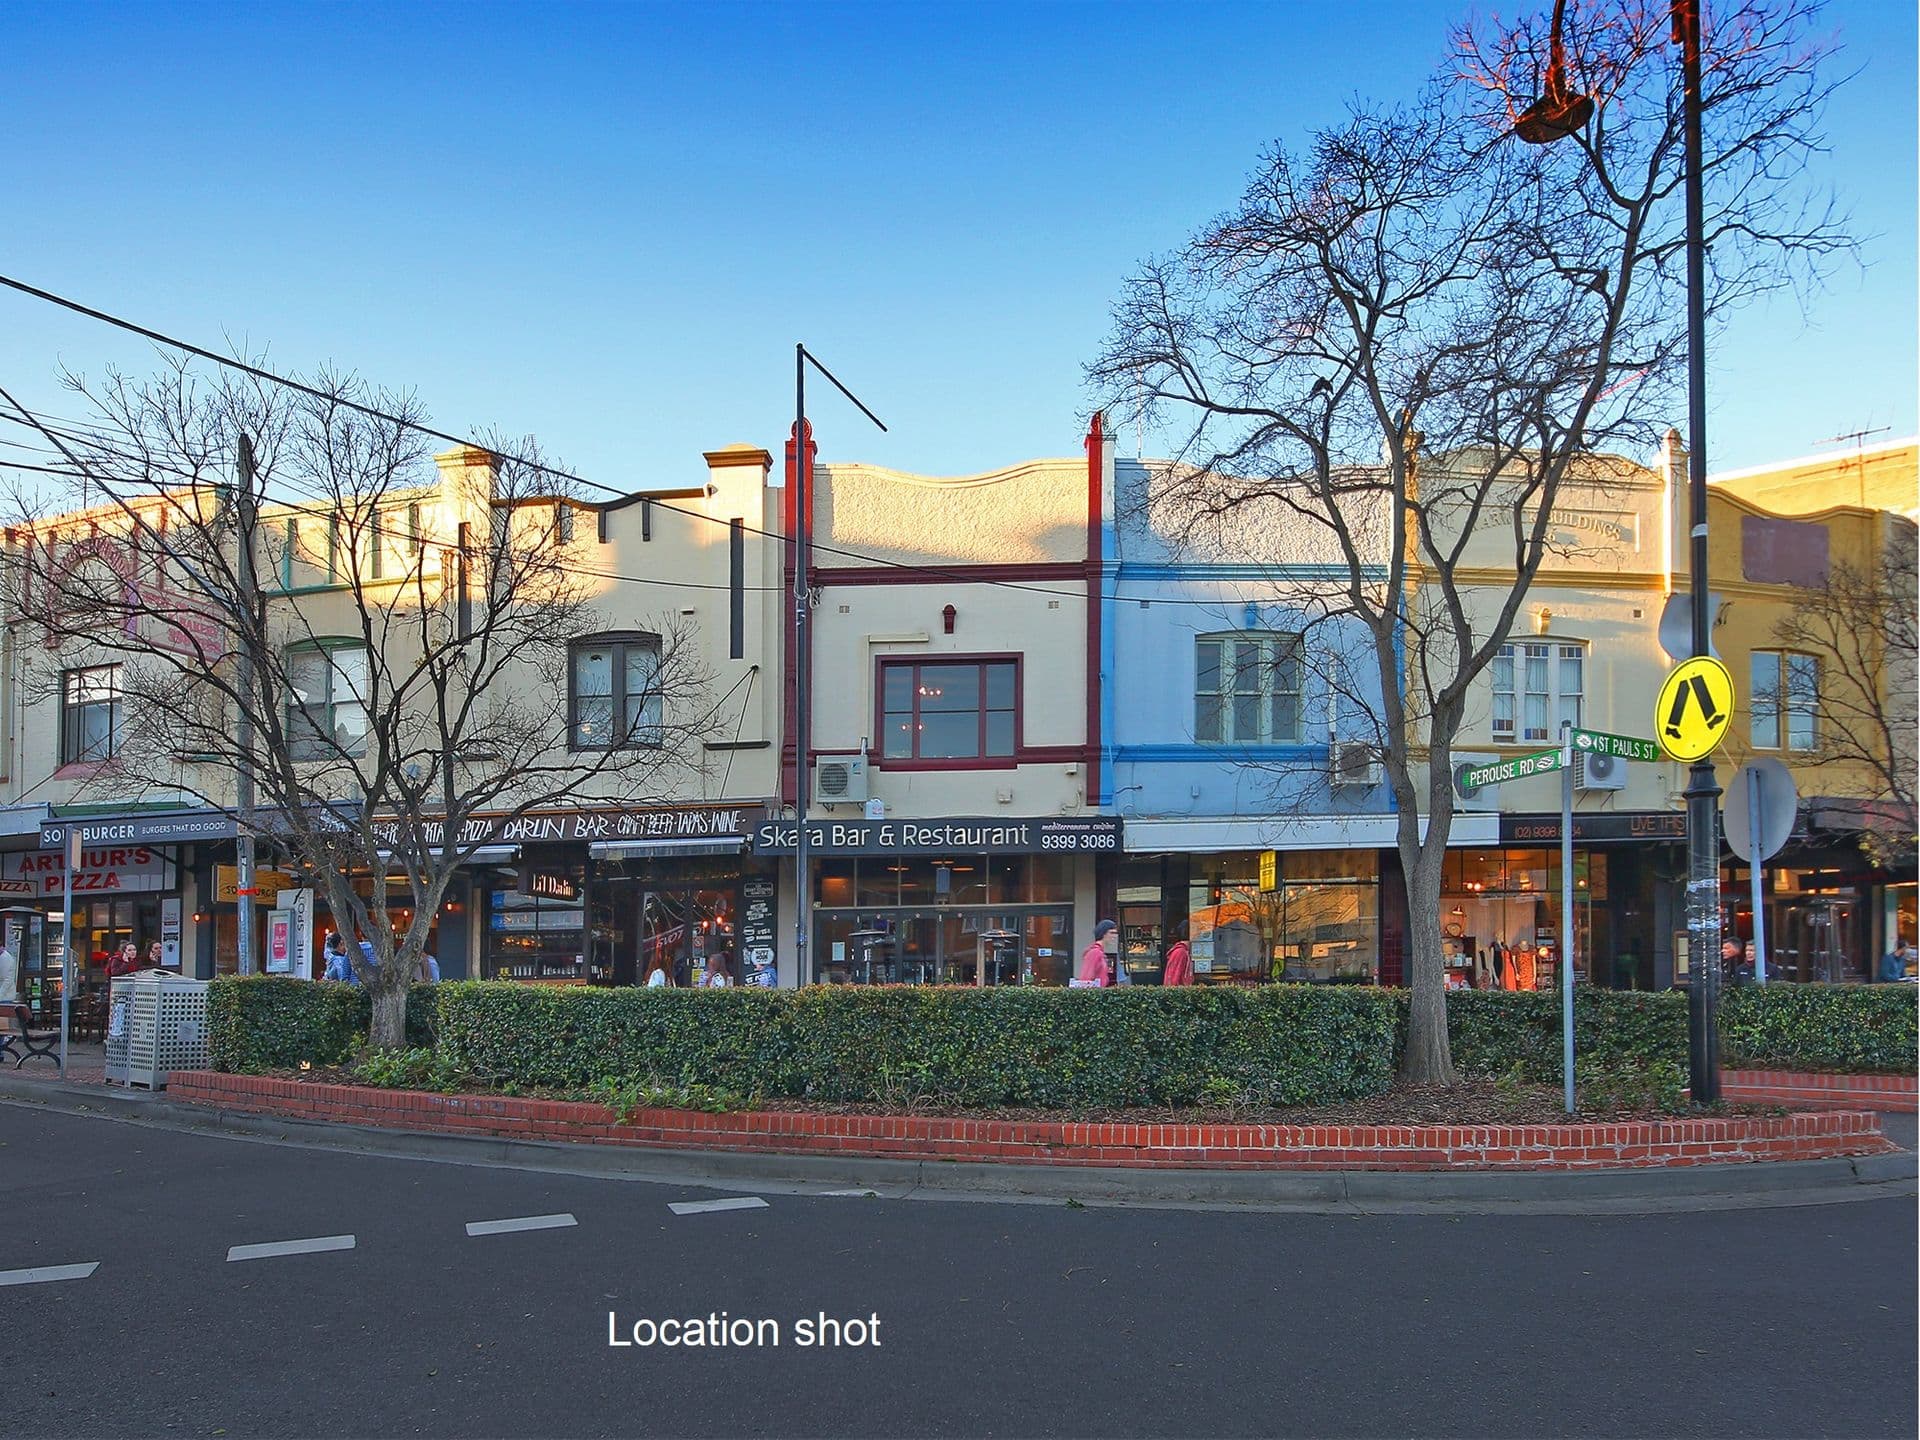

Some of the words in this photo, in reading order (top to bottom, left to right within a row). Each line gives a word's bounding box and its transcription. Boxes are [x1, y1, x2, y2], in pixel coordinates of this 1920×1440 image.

[1548, 510, 1621, 541] BUILDINGS
[1598, 738, 1609, 752] ST
[1612, 740, 1640, 758] PAULS
[1643, 744, 1654, 759] ST
[1469, 762, 1516, 786] PEROUSE
[1519, 759, 1534, 774] RD
[83, 825, 135, 841] BURGER
[142, 825, 171, 835] BURGERS
[173, 824, 189, 832] THAT
[191, 823, 201, 831] DO
[203, 821, 226, 831] GOOD
[464, 820, 493, 841] PIZZA
[503, 818, 565, 839] DARLIN
[574, 815, 610, 837] BAR
[677, 812, 708, 834] TAPAS
[711, 811, 741, 833] WINE
[832, 826, 871, 846] Bar
[879, 826, 894, 846] &
[903, 824, 1029, 846] Restaurant
[1041, 822, 1091, 831] mediterranean
[1092, 822, 1116, 831] cuisine
[1515, 826, 1532, 838] (02)
[1041, 835, 1077, 849] 9399
[1080, 834, 1115, 848] 3086
[296, 940, 304, 968] THE
